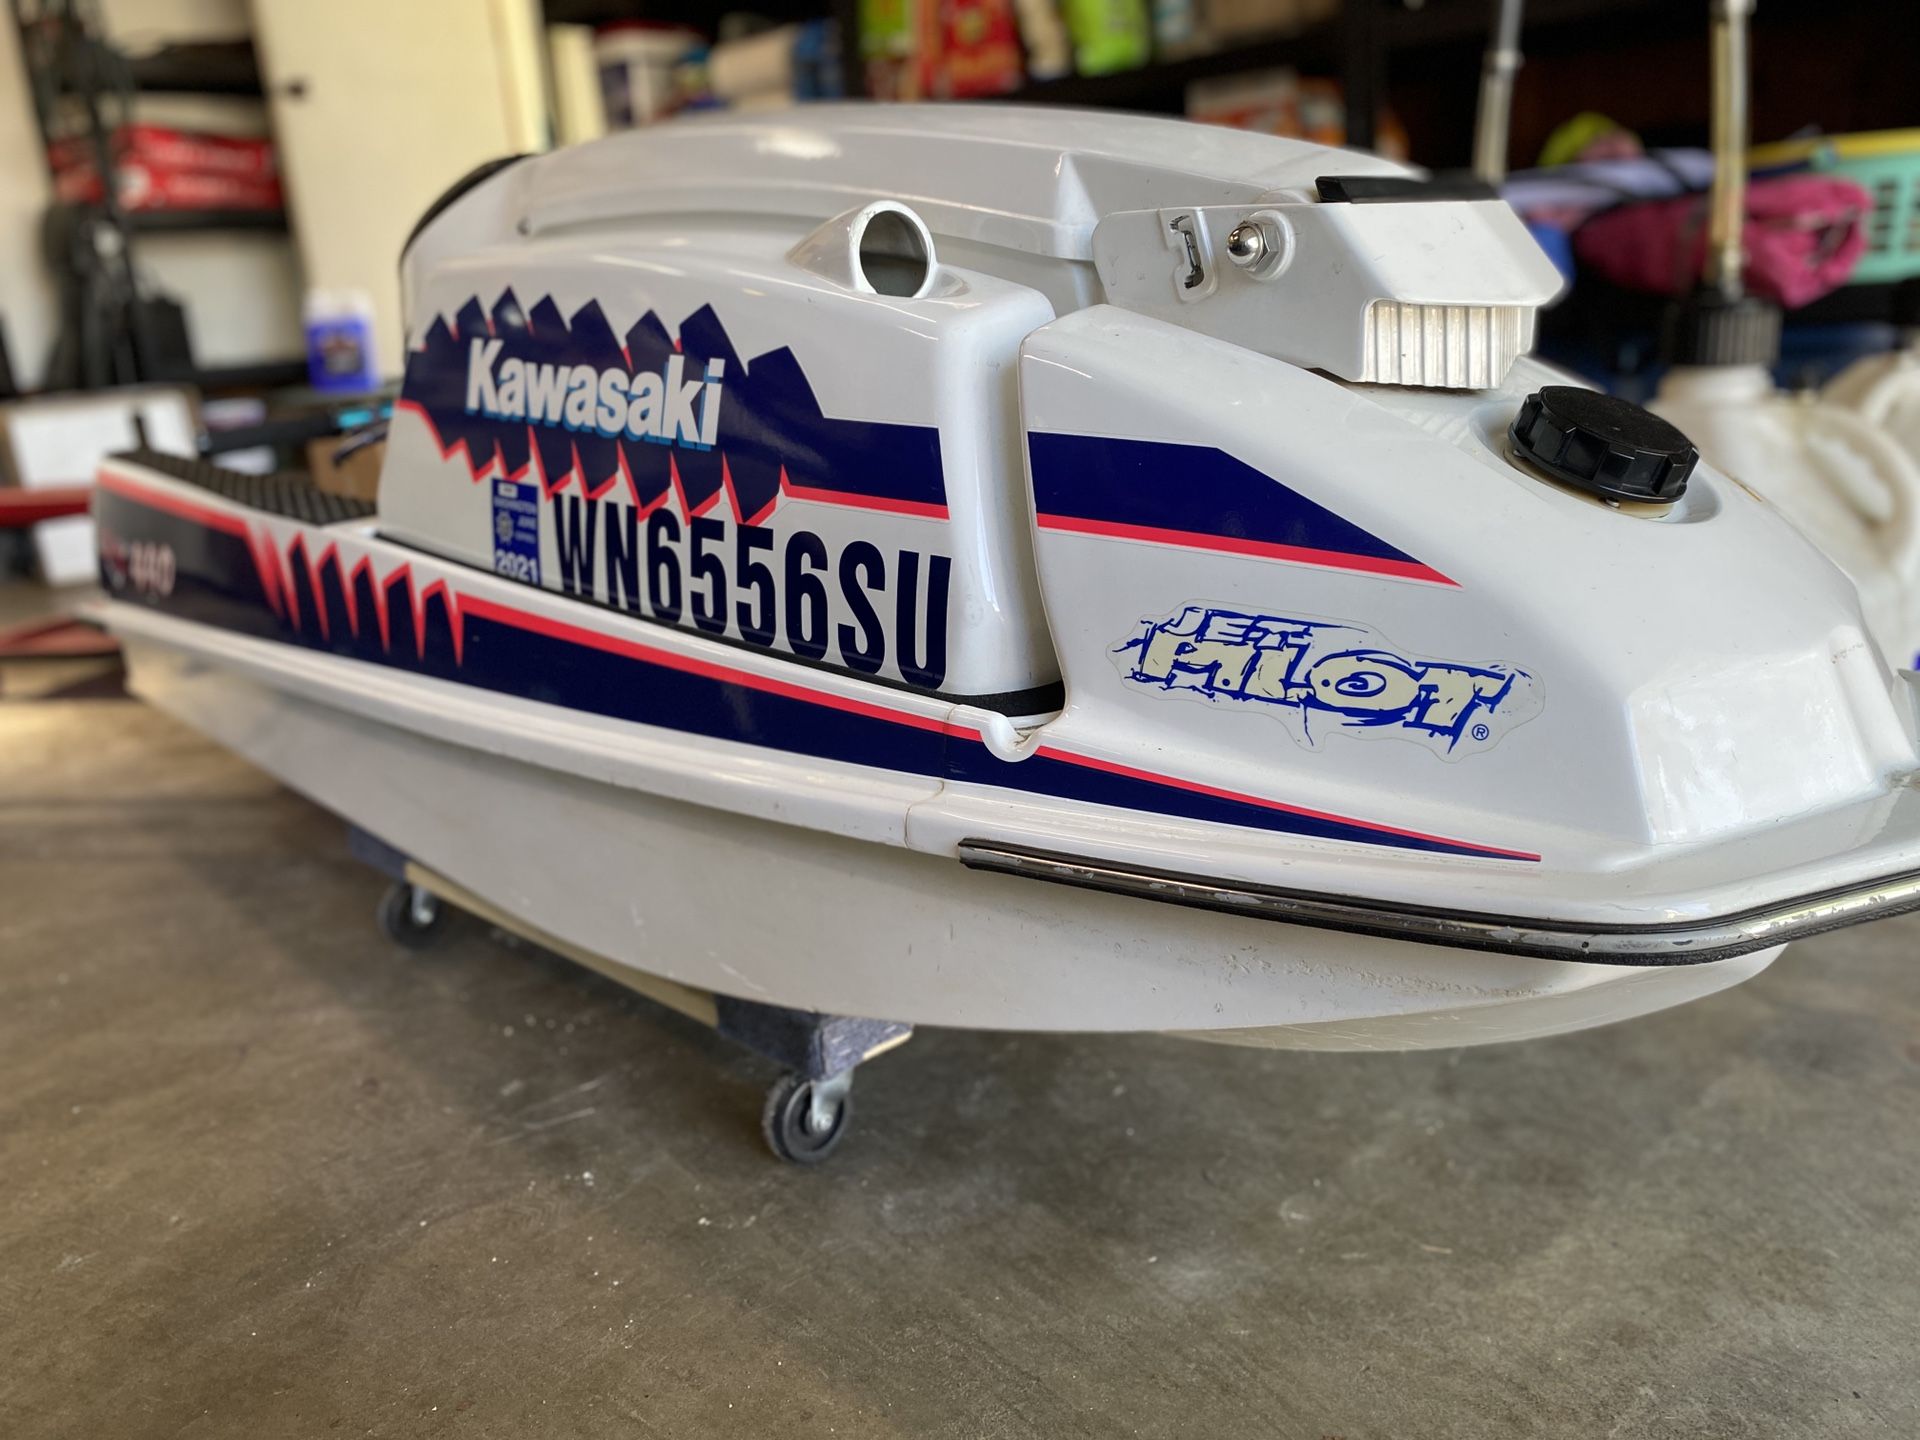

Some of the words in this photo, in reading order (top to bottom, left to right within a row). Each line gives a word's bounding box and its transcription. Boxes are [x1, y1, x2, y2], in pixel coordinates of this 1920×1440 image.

[465, 337, 726, 451] Kawasaki
[495, 548, 539, 585] 2021
[552, 492, 952, 691] WN6556SU
[1158, 606, 1316, 649] JET
[1128, 638, 1508, 748] PILOT
